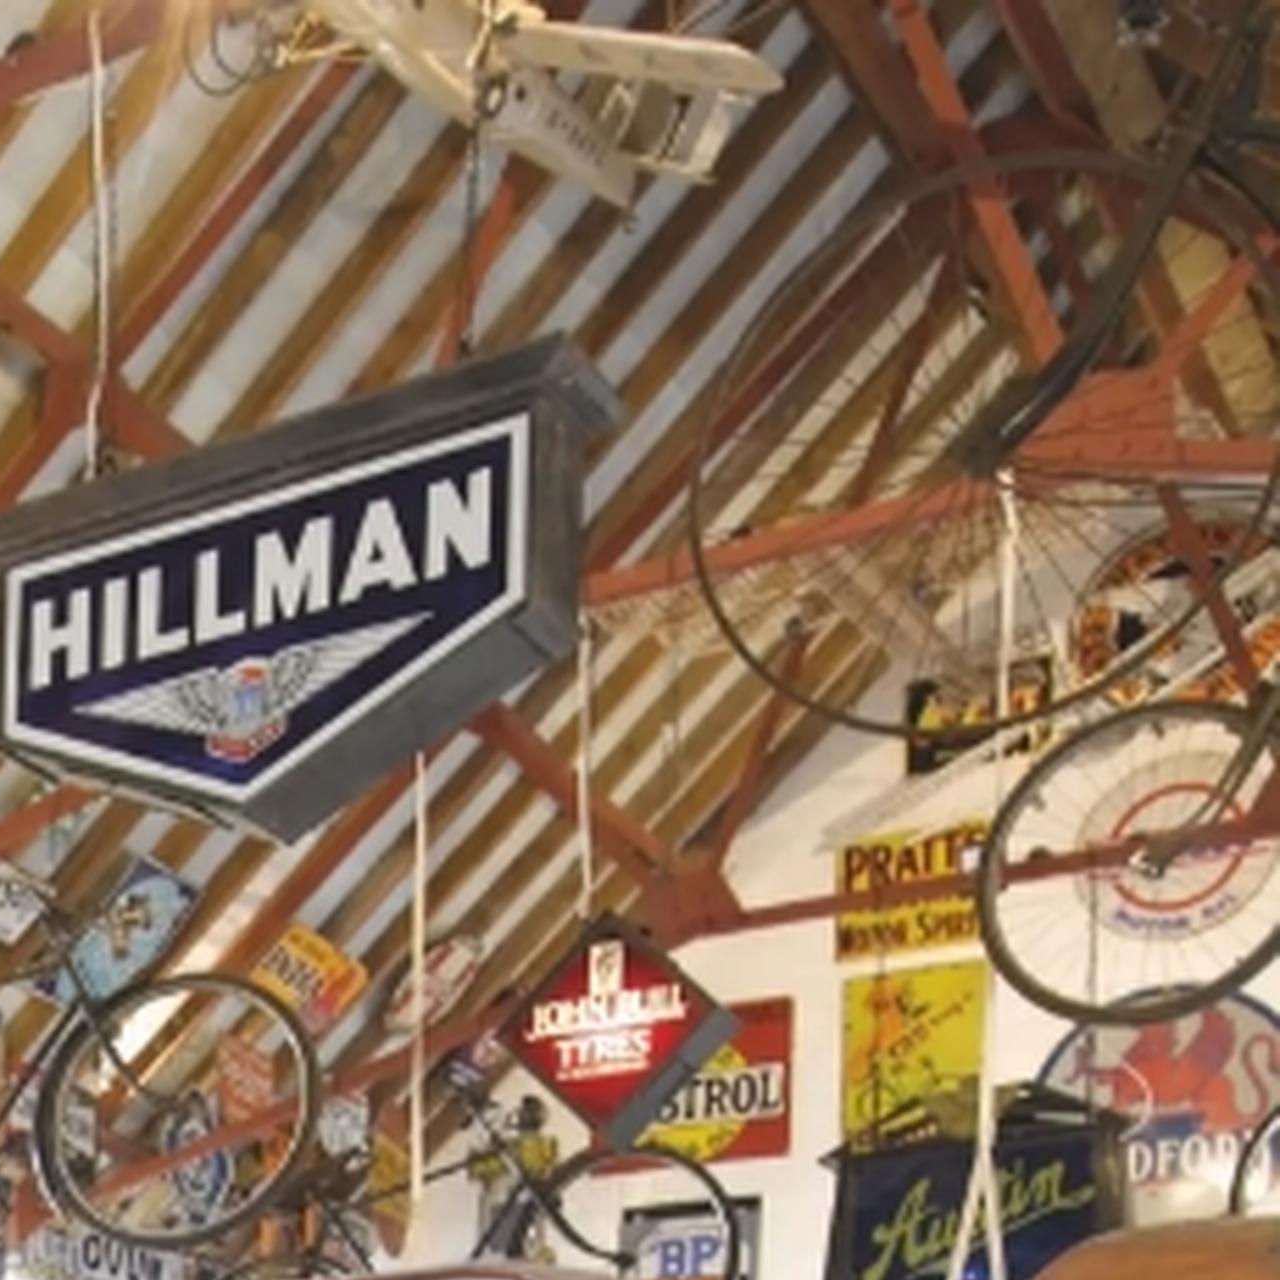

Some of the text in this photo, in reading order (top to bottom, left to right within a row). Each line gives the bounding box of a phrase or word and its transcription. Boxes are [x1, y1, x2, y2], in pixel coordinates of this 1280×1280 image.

[29, 465, 493, 691] HILLMAN
[555, 1028, 652, 1069] TYRES
[659, 1067, 781, 1123] STROL
[656, 1234, 722, 1277] BP
